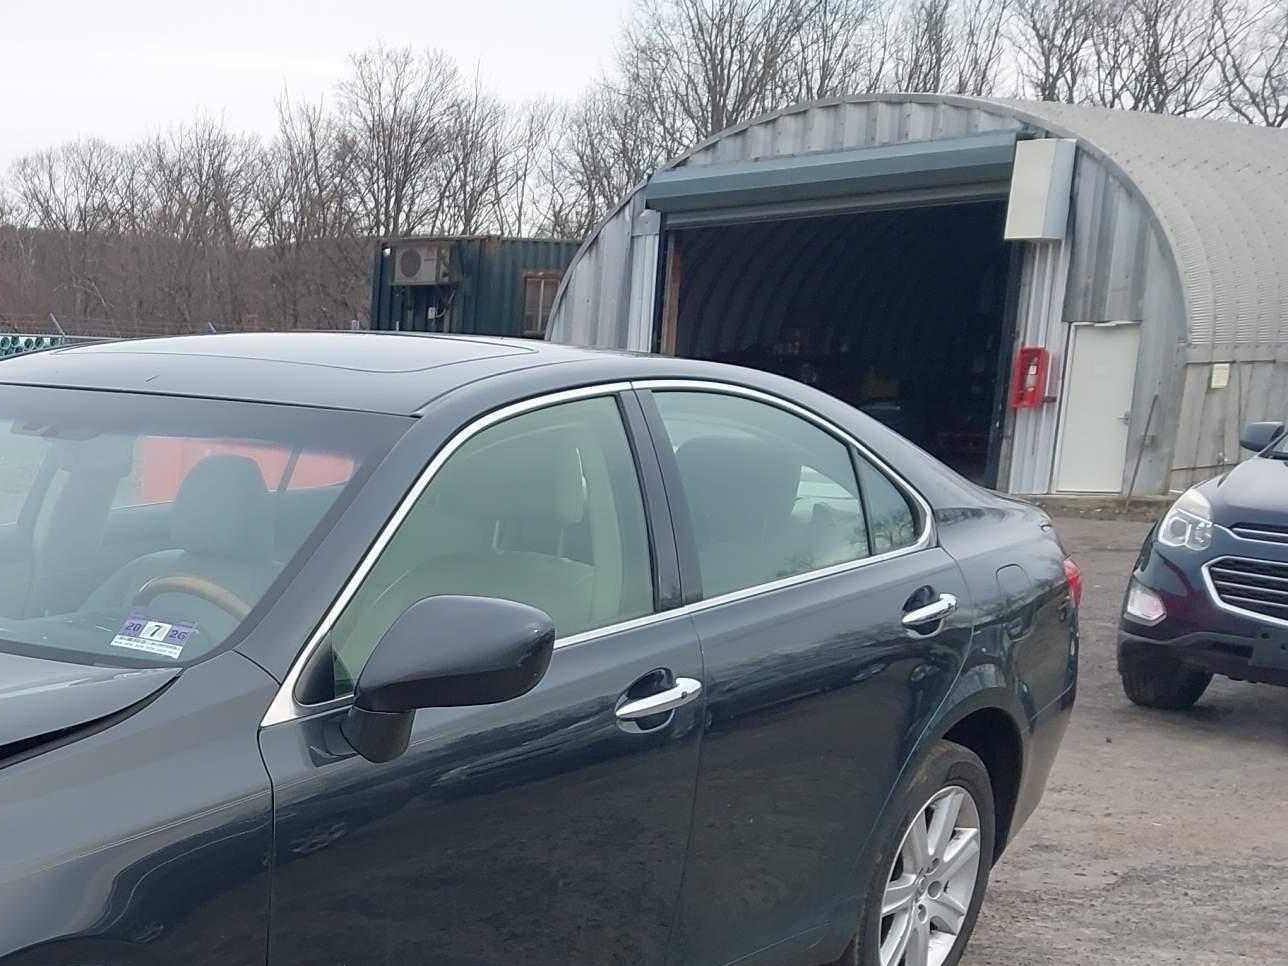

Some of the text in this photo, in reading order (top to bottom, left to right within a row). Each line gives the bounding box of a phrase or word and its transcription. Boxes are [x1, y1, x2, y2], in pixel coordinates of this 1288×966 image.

[125, 623, 142, 632] 20
[149, 624, 162, 637] 7
[169, 630, 187, 641] 26
